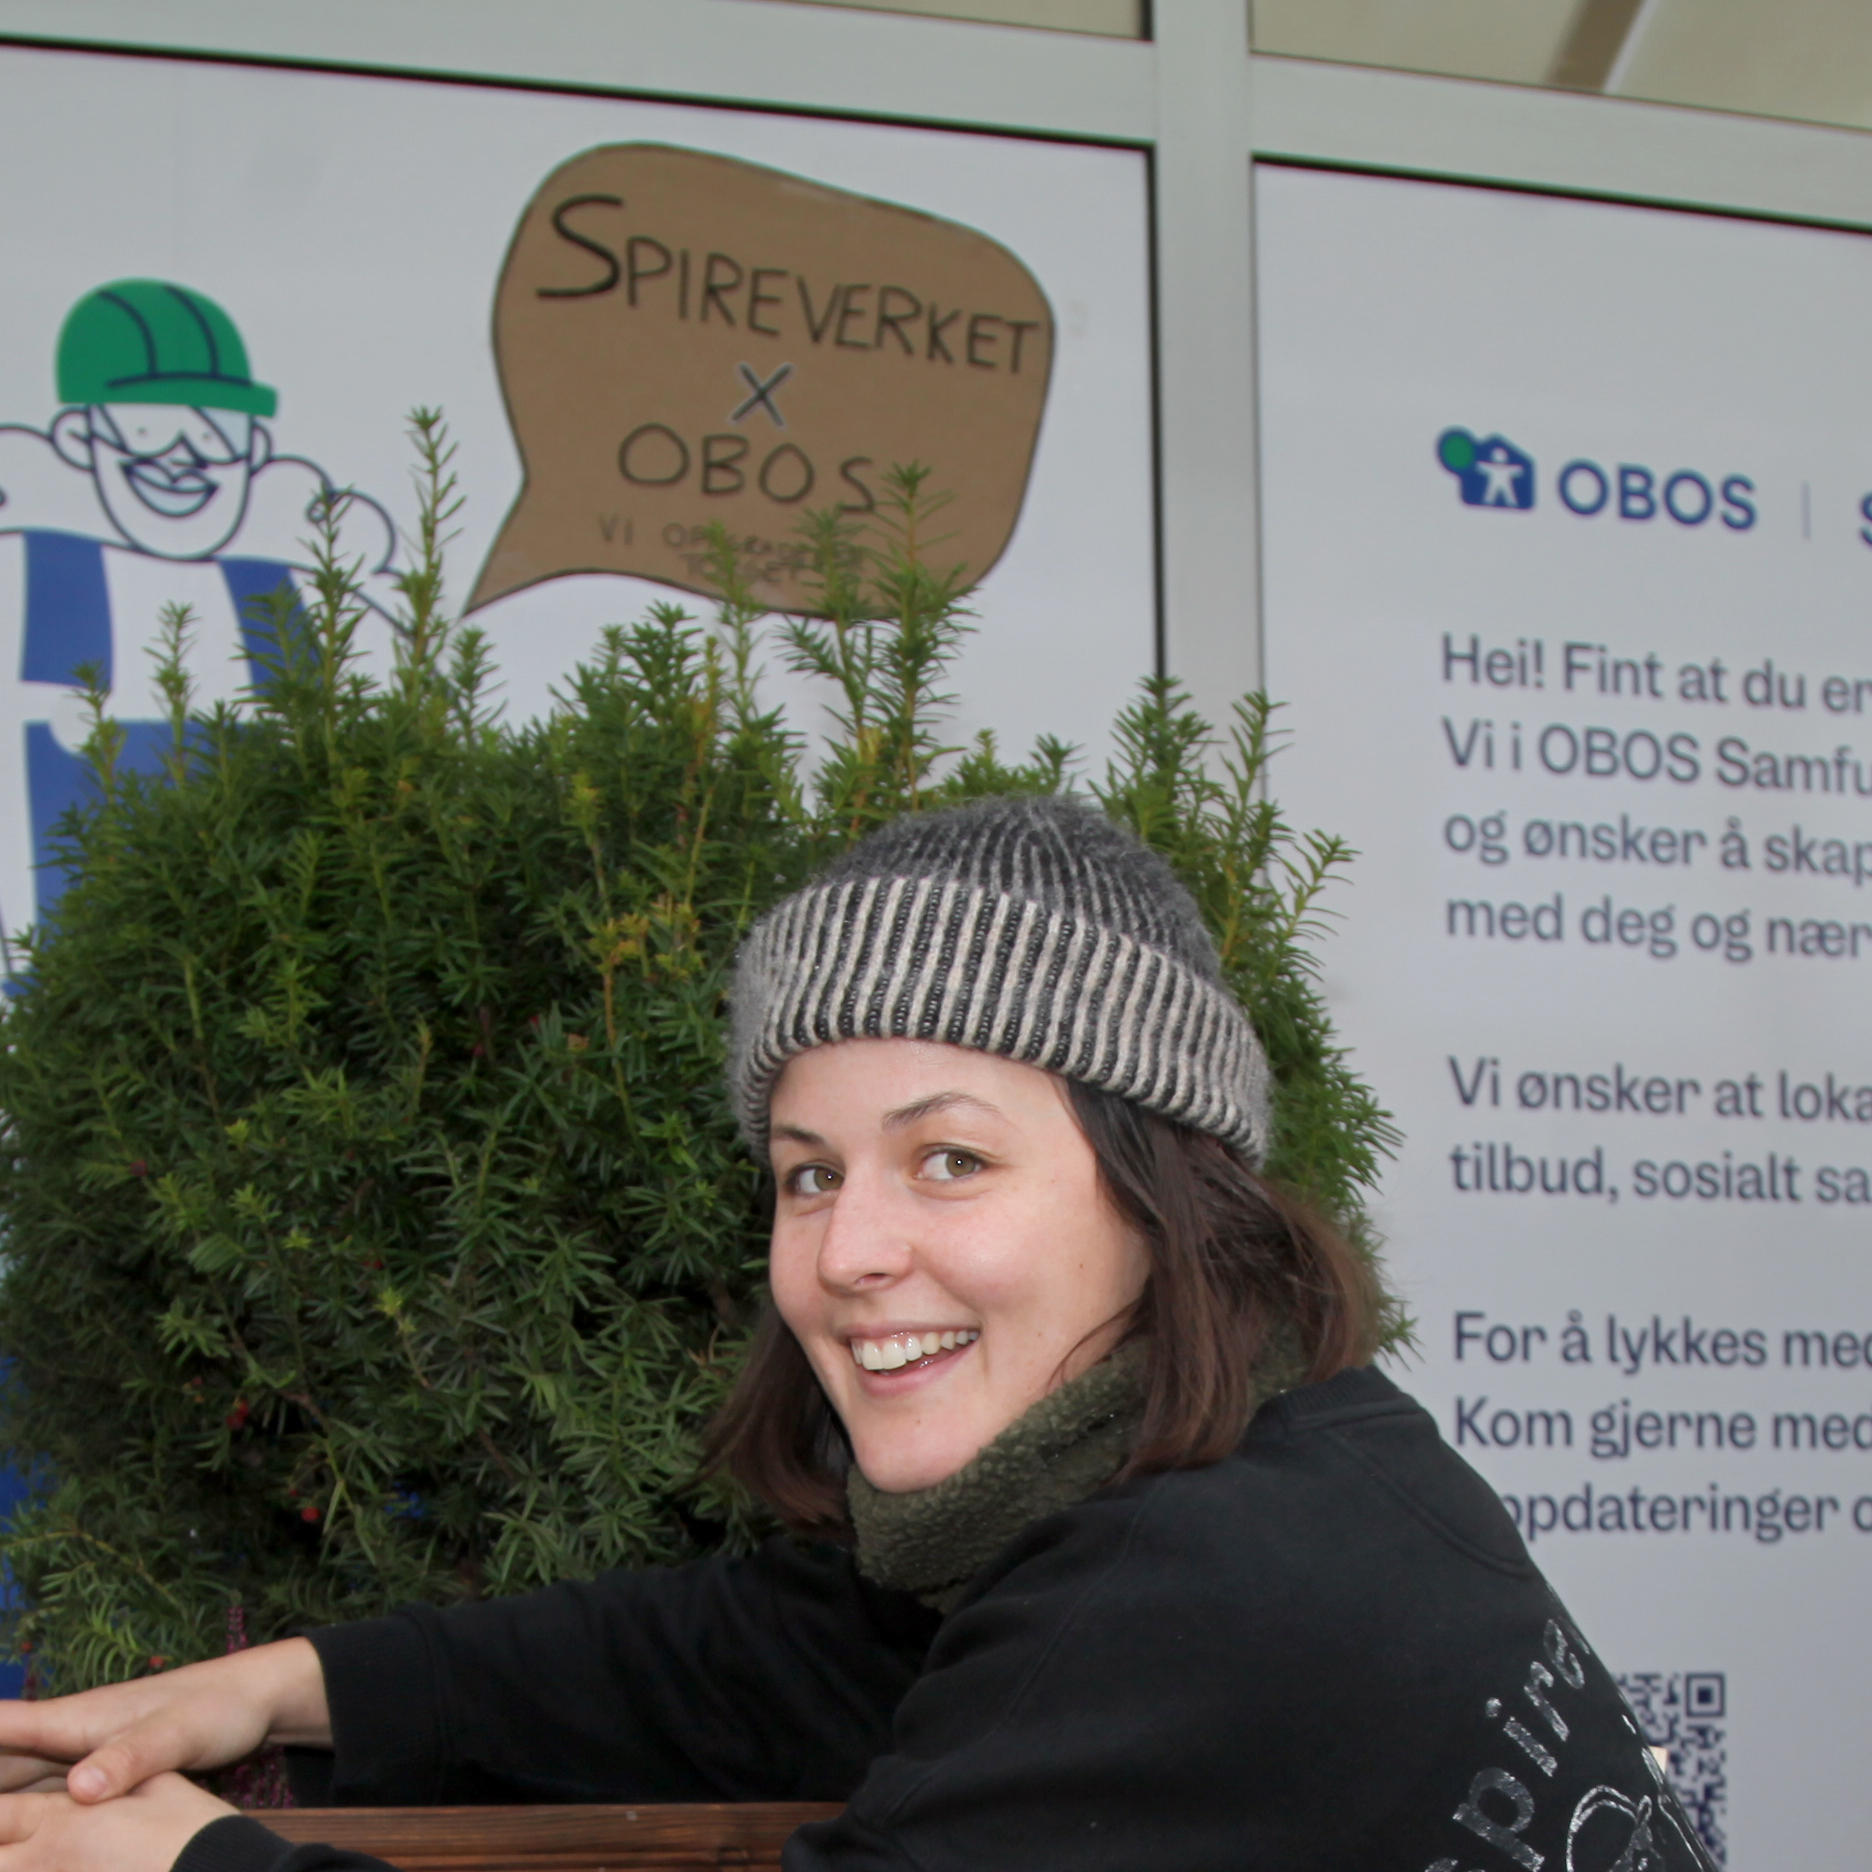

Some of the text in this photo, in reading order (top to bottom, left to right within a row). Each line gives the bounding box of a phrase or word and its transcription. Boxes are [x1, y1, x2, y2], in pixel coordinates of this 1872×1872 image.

[536, 193, 1039, 373] SPIREVERKET
[618, 422, 877, 514] OBOS
[1556, 458, 1759, 532] OBOS
[1442, 631, 1544, 689] Hei!
[1563, 640, 1665, 698] Fint
[1678, 657, 1729, 703] at
[1742, 659, 1807, 709] du
[1442, 715, 1494, 769] Vi
[1511, 721, 1523, 771] i
[1539, 722, 1702, 784] OBOS
[1443, 809, 1509, 866] og
[1523, 812, 1708, 867] ønsker
[1721, 814, 1751, 870] å
[1447, 892, 1564, 943] med
[1581, 896, 1678, 959] deg
[1691, 908, 1754, 964] og
[1448, 1056, 1501, 1109] Vi
[1516, 1063, 1702, 1116] ønsker
[1714, 1071, 1765, 1120] at
[1450, 1140, 1619, 1203] tilbud,
[1632, 1151, 1802, 1205] sosialt
[1453, 1310, 1549, 1365] For
[1561, 1309, 1591, 1365] å
[1606, 1314, 1768, 1375] lykkes
[1454, 1397, 1573, 1449] Kom
[1589, 1400, 1757, 1461] gjerne
